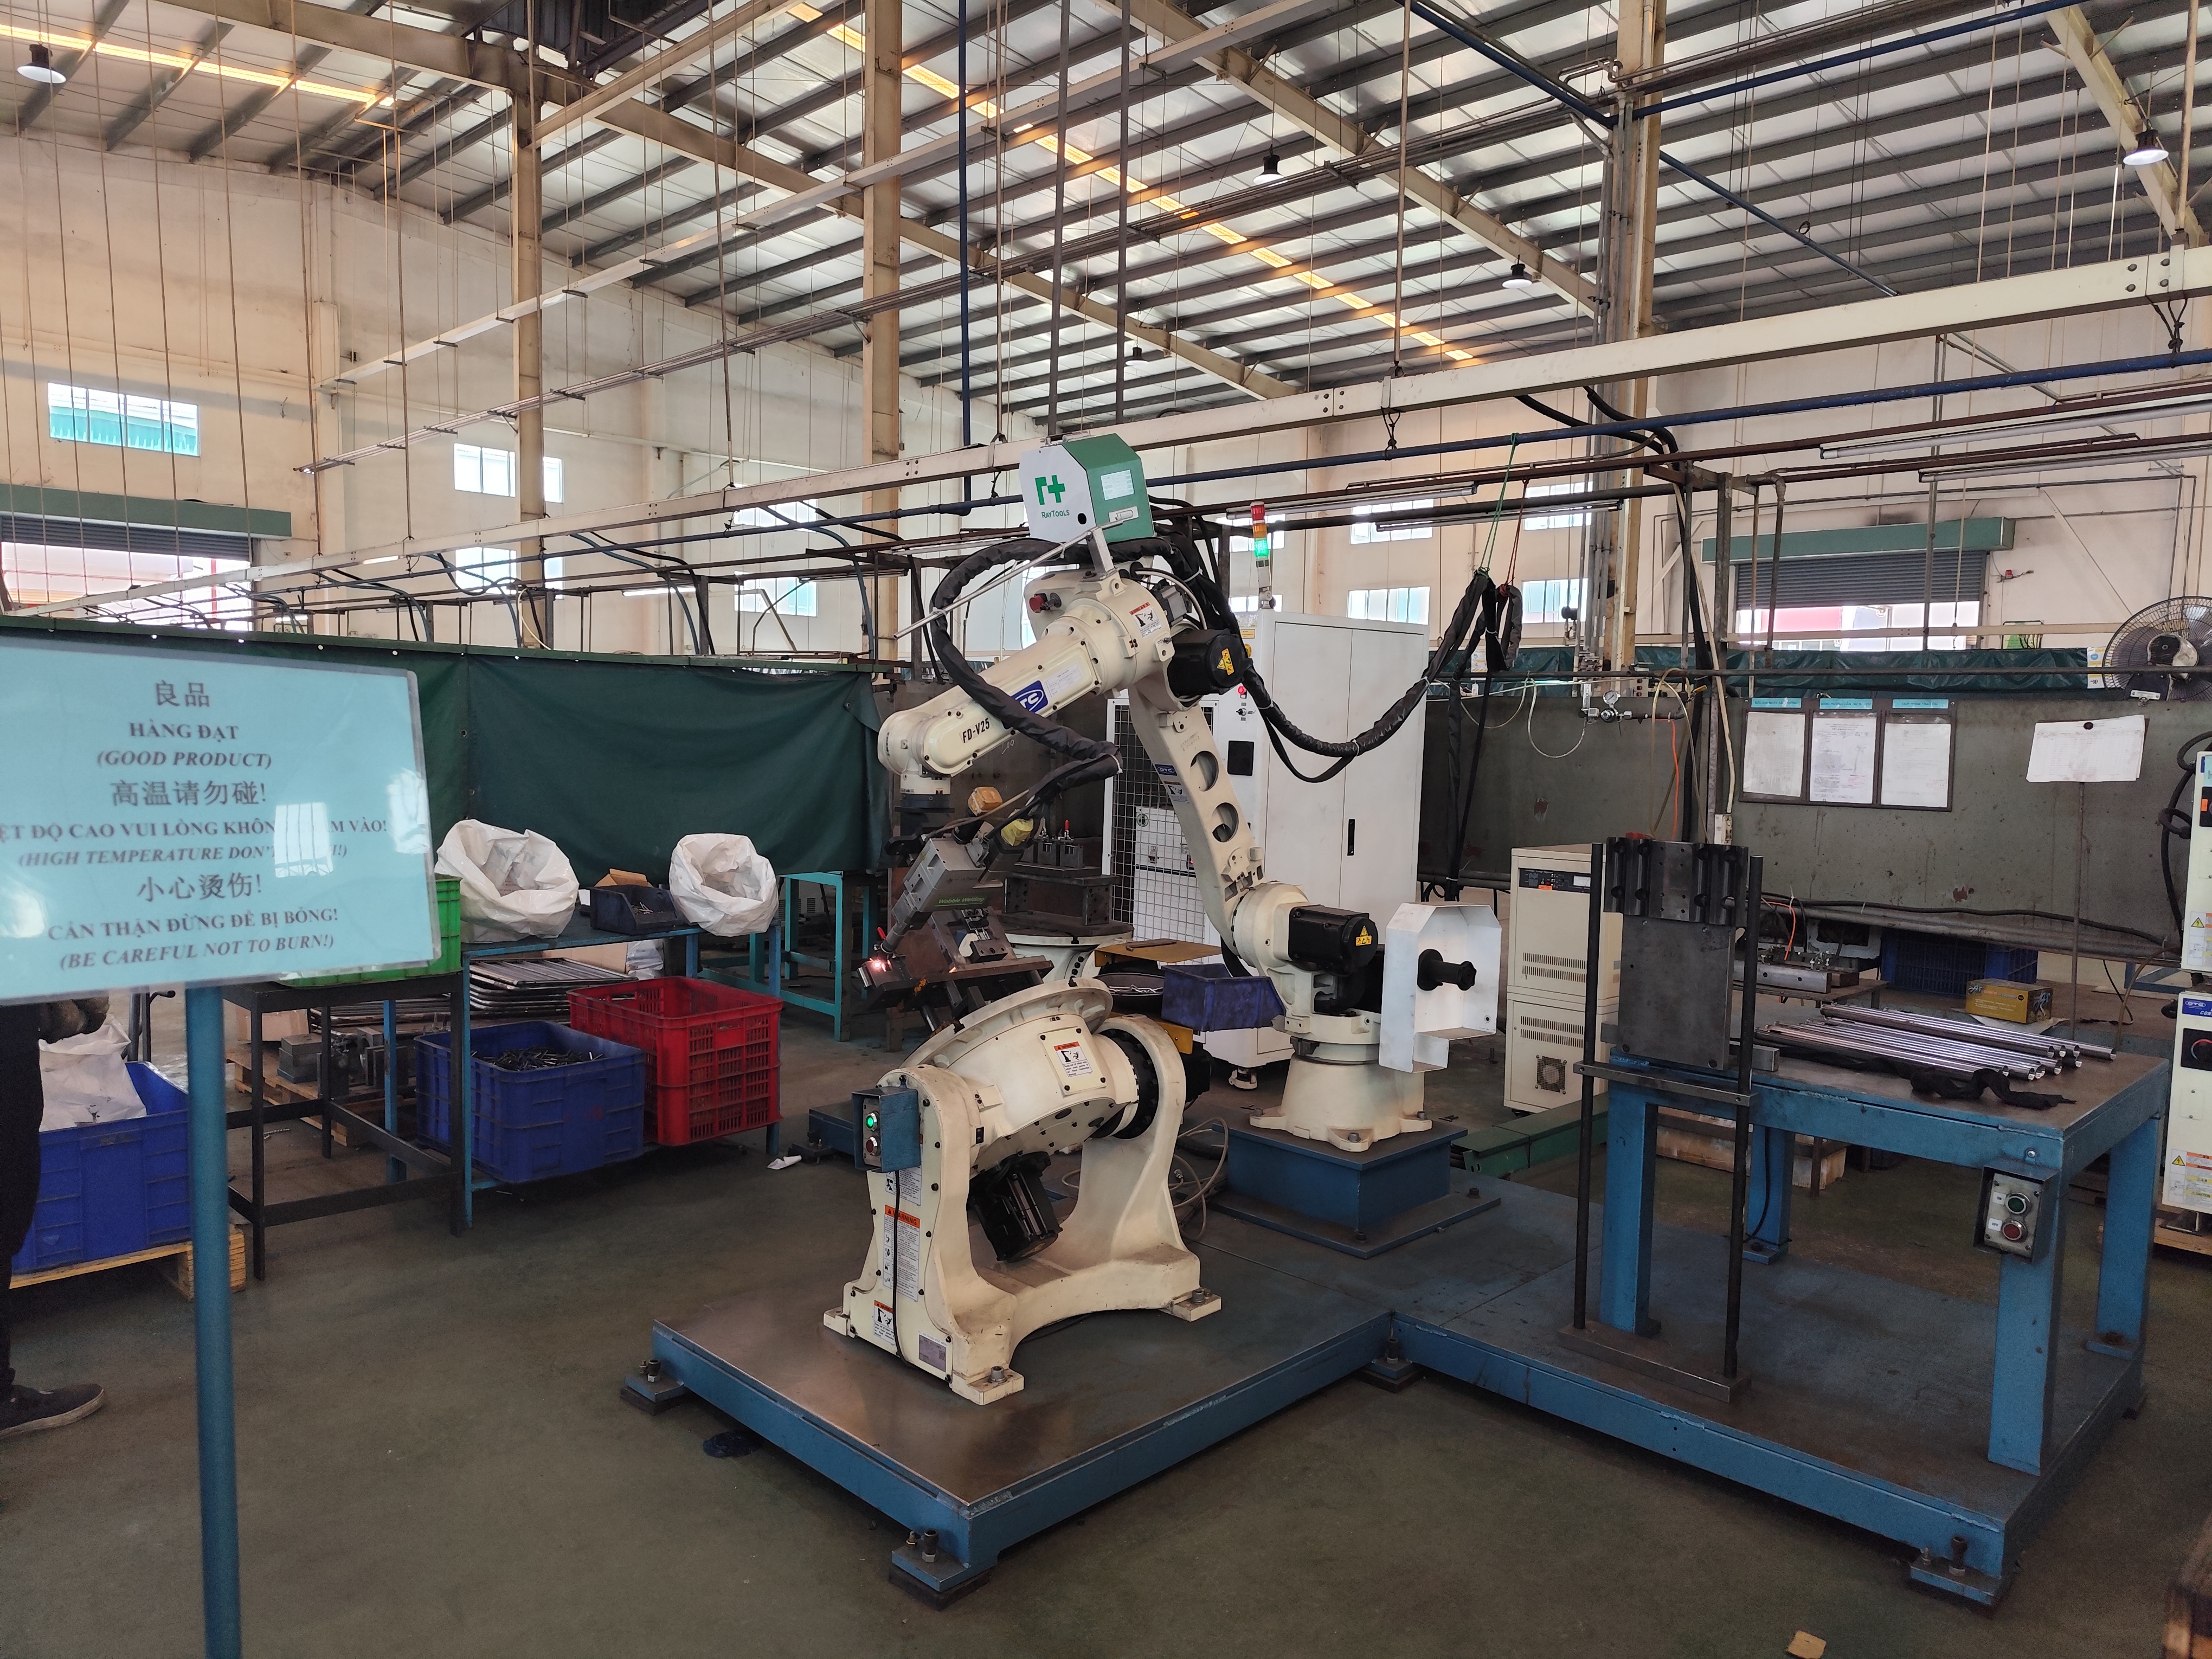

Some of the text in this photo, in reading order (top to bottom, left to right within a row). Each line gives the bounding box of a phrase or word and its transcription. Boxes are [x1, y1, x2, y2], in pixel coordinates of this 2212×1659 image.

[155, 679, 210, 707] 良品
[129, 719, 239, 743] HÀNG ĐẠT
[962, 717, 991, 743] FD-V25
[97, 750, 272, 770] (GOOD PRODUCT)
[110, 780, 266, 807] 高温请勿碰!
[31, 822, 63, 842] ĐỘ
[69, 822, 115, 839] CAO
[120, 822, 158, 837] VUI
[163, 818, 218, 837] LÒNG
[224, 817, 275, 835] KHÔN
[349, 816, 388, 833] VÀO!
[18, 851, 81, 868] (HIGH
[86, 846, 223, 864] TEMPERATURE
[137, 872, 262, 902] 小心烫伤!
[101, 918, 161, 938] THẬN
[261, 911, 279, 928] BỊ
[284, 906, 338, 924] BỎNG!
[60, 934, 334, 970] (BE CAREFUL NOT TO BURN!)
